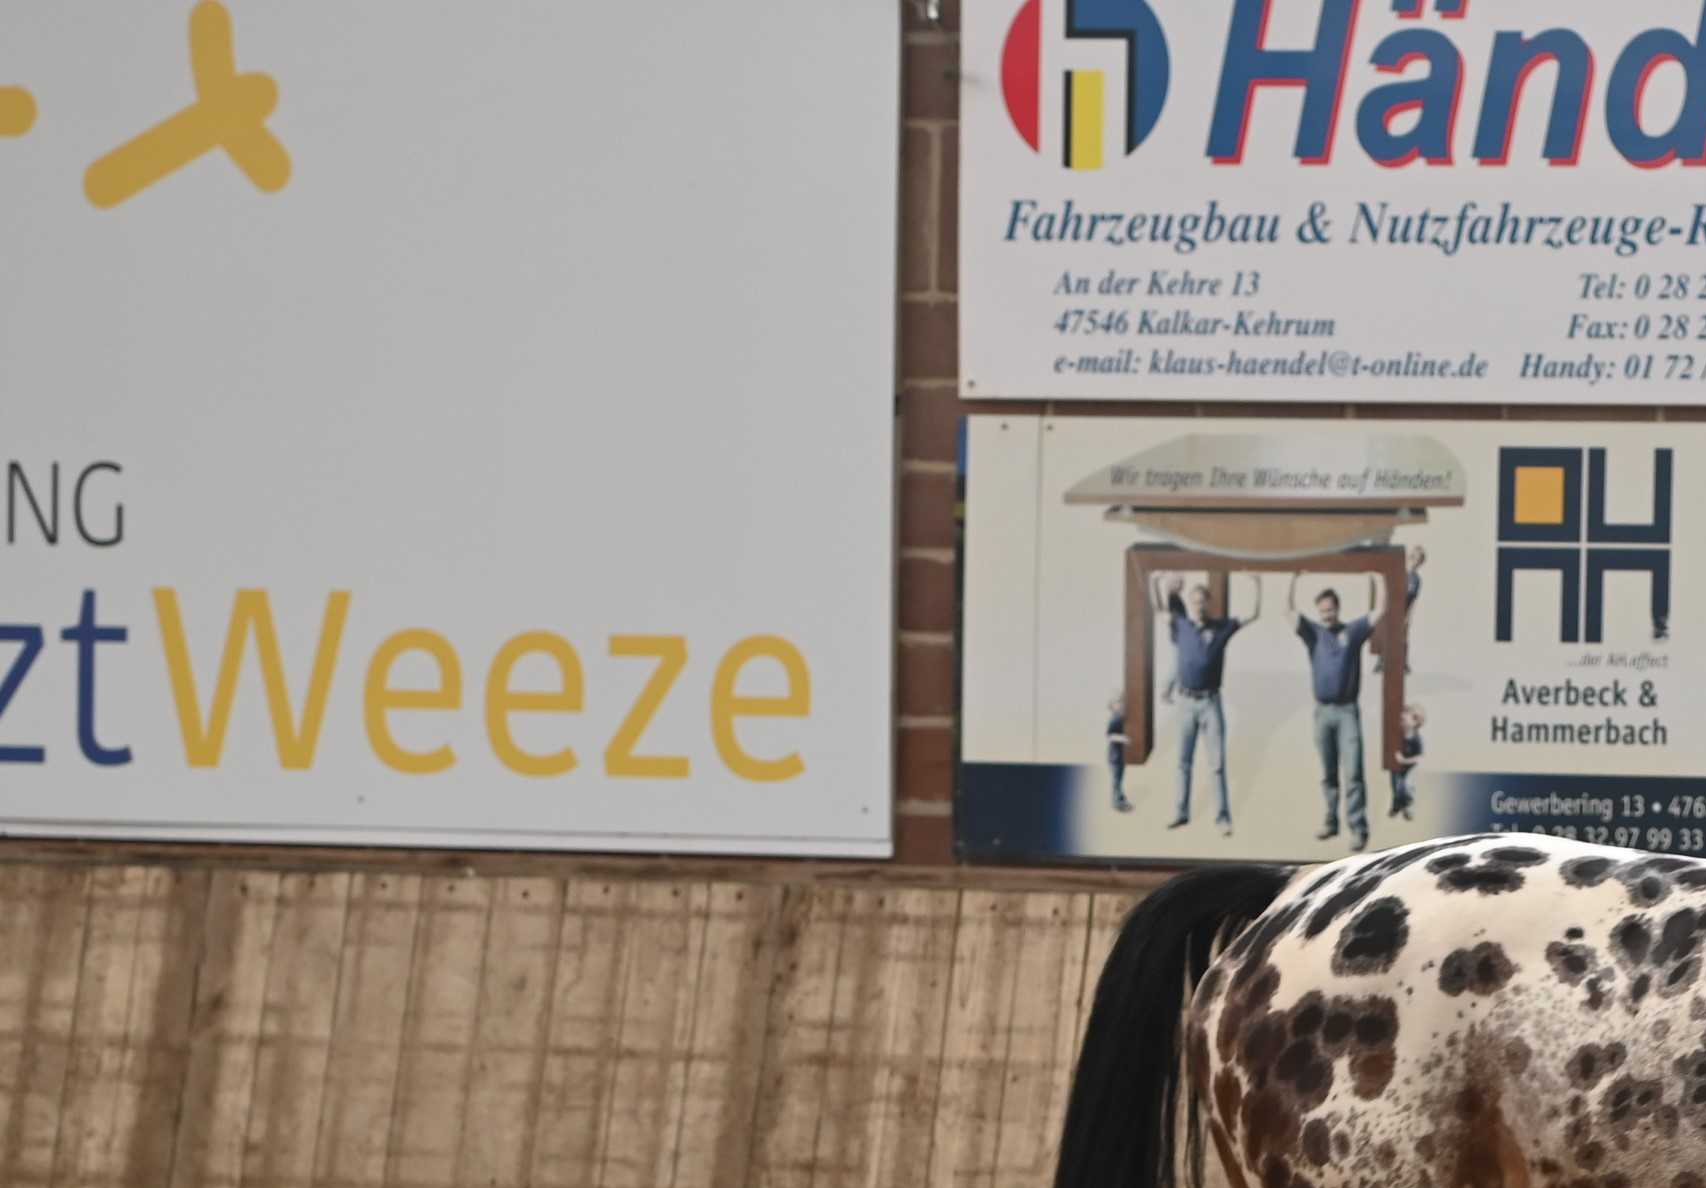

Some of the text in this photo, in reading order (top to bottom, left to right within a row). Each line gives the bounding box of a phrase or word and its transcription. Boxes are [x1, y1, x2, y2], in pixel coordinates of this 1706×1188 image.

[1005, 200, 1280, 253] Fahrzeugbau
[1296, 203, 1330, 244] &
[1054, 269, 1260, 296] An der Kehre 13
[1580, 273, 1626, 299] Tel:
[1634, 274, 1651, 299] 0
[1658, 274, 1690, 299] 28
[1054, 309, 1335, 336] 47546 Kalkar-Kehrum
[1568, 314, 1628, 339] Fax:
[1634, 315, 1650, 338] 0
[1658, 314, 1689, 340] 28
[1053, 349, 1488, 378] e-mail: klaus-haendel@t-online.de
[1520, 353, 1615, 385] Handy:
[1624, 355, 1653, 379] 01
[1666, 354, 1694, 379] 72
[1110, 466, 1454, 494] Wir tragen Ihre Wünsche auf Händen!
[1502, 678, 1657, 706] Averbeck &
[1491, 716, 1668, 745] Hammerbach
[1491, 791, 1613, 822] Gewerbering
[1620, 795, 1645, 816] 13
[1646, 827, 1672, 849] 99
[1679, 828, 1704, 850] 33
